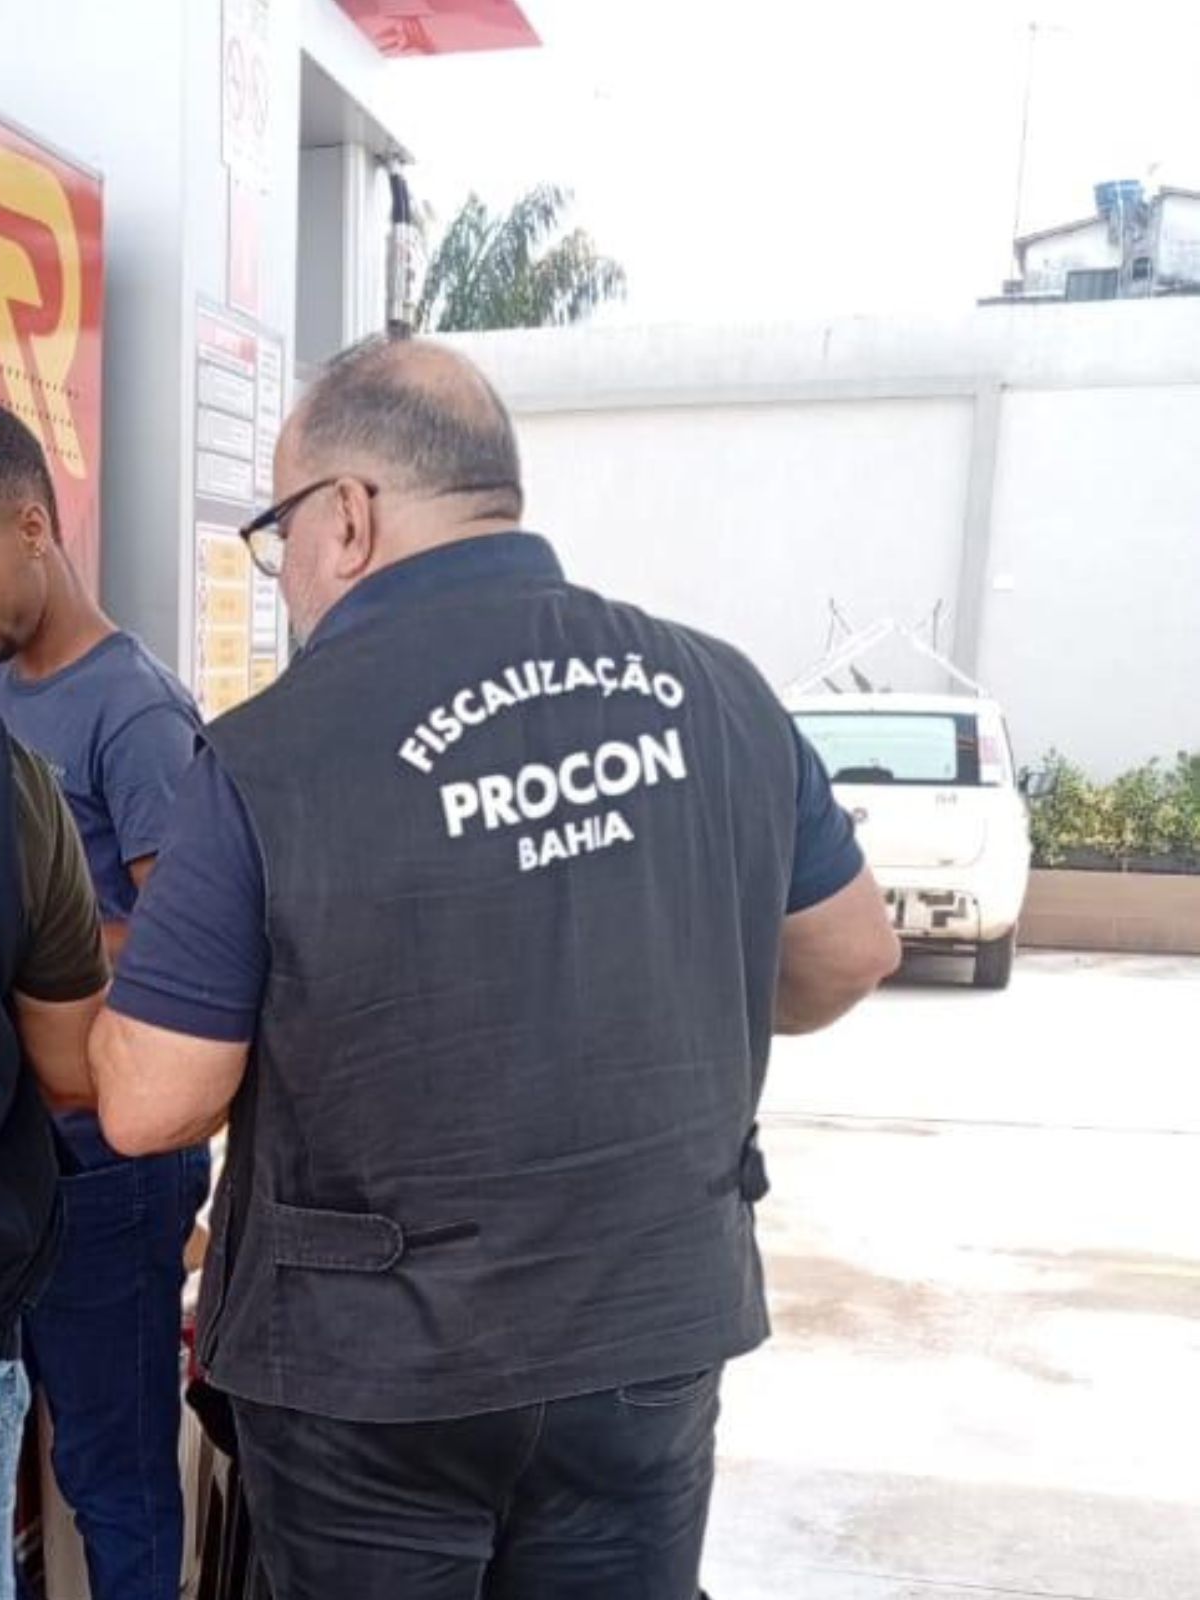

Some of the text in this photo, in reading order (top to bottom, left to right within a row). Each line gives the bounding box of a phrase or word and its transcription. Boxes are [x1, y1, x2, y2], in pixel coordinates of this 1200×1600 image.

[398, 652, 684, 774] FISCALIZAÇÃO
[440, 728, 688, 838] PROCON
[518, 810, 635, 871] BAHIA
